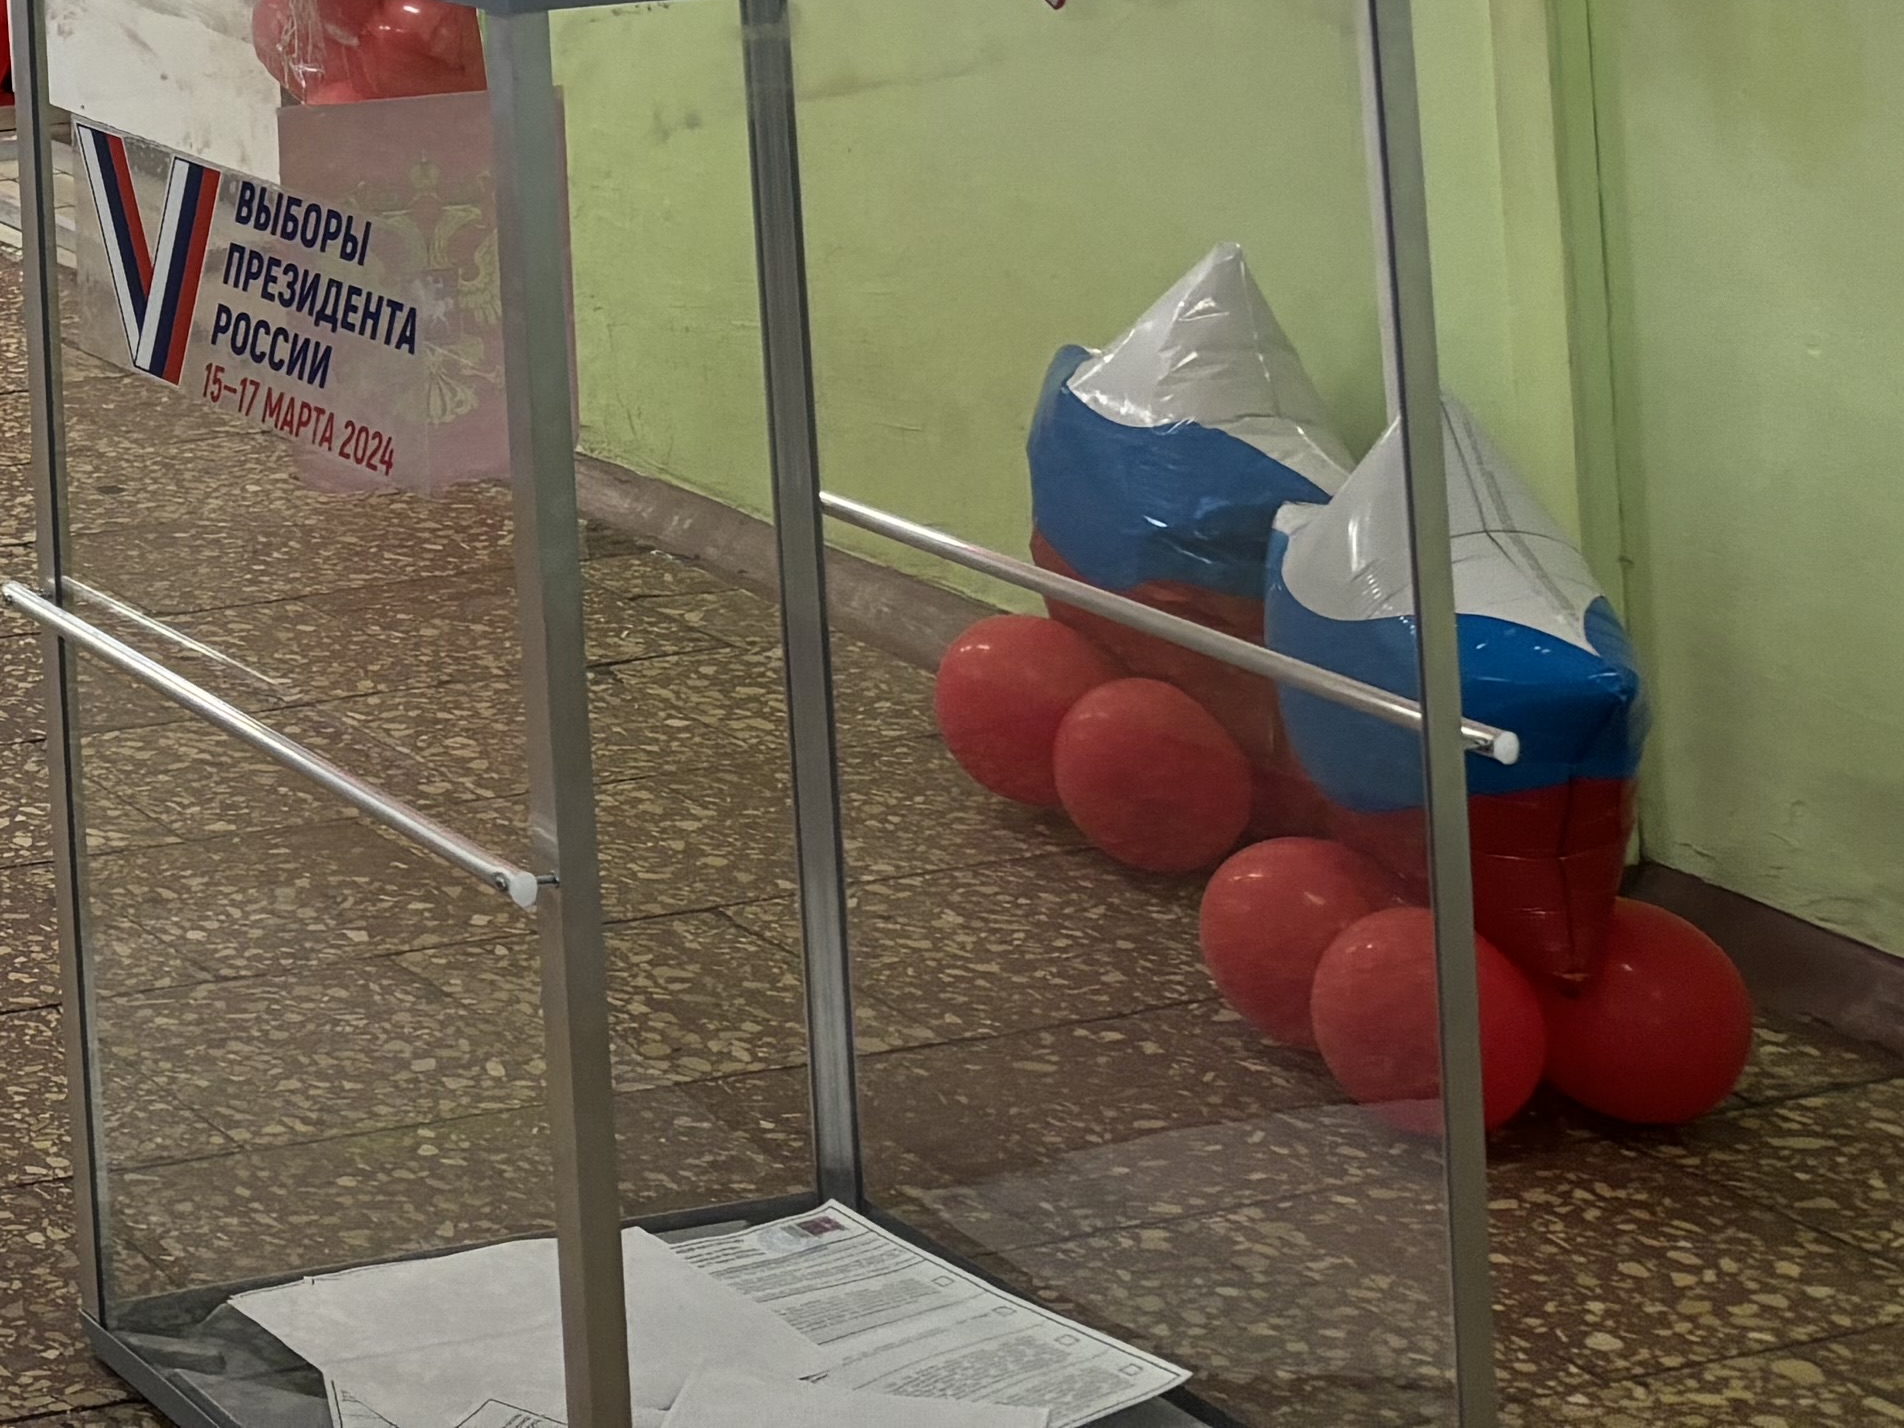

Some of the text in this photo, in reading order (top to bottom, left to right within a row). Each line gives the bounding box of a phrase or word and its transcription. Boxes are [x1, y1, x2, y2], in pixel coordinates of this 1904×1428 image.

[235, 181, 372, 266] ВЫБОРЫ
[222, 242, 418, 355] ПРЕЗИДЕНТА
[210, 303, 333, 389] РОССИИ
[262, 390, 334, 453] МАРТА
[338, 420, 395, 477] 2024
